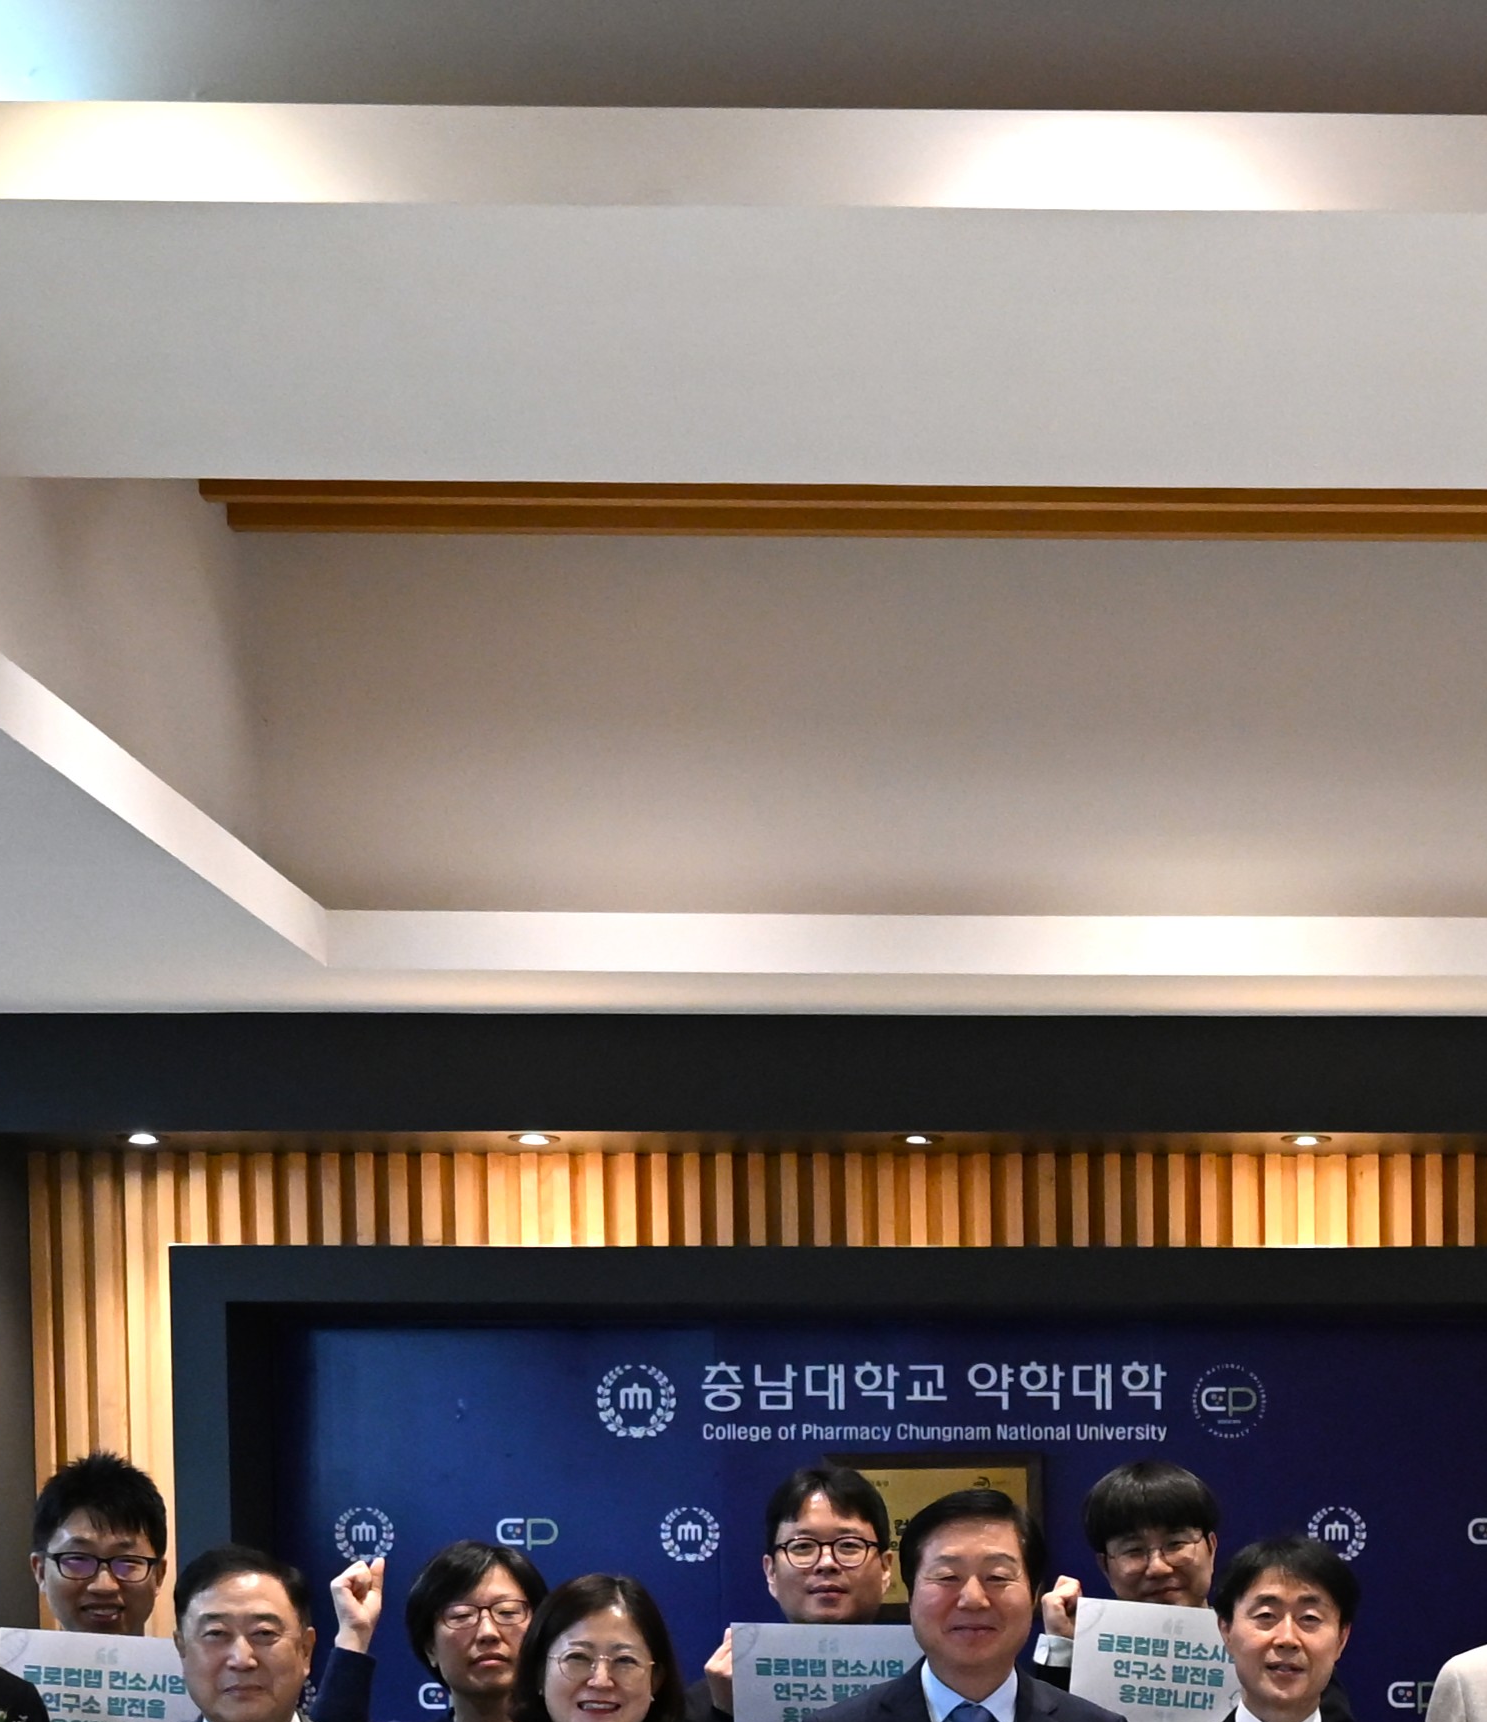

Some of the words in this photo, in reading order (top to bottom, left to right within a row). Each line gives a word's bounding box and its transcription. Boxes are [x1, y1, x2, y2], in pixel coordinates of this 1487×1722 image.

[702, 1362, 947, 1411] 충남대학교
[968, 1362, 1166, 1410] 약학대학
[703, 1424, 771, 1441] College
[778, 1424, 796, 1440] of
[802, 1424, 891, 1441] Pharmacy
[897, 1423, 990, 1441] Chungnam
[997, 1424, 1070, 1440] National
[1077, 1424, 1166, 1441] University
